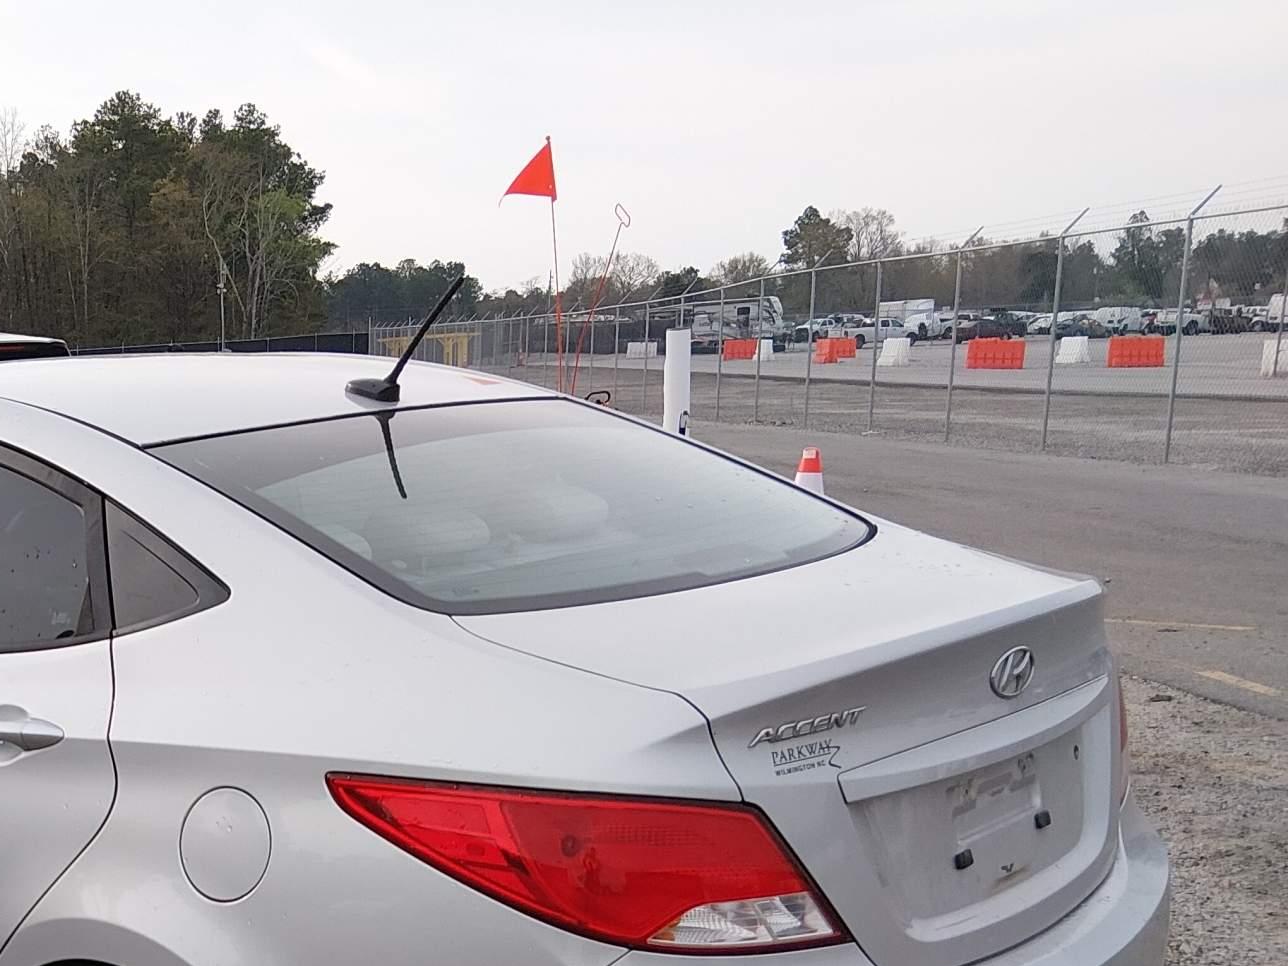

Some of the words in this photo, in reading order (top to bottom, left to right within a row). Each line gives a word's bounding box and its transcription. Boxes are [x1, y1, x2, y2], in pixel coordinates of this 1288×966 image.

[747, 706, 867, 749] ACCENT
[771, 739, 832, 765] PARKWAY
[774, 763, 816, 776] WILMINGTON
[816, 759, 827, 769] NC
